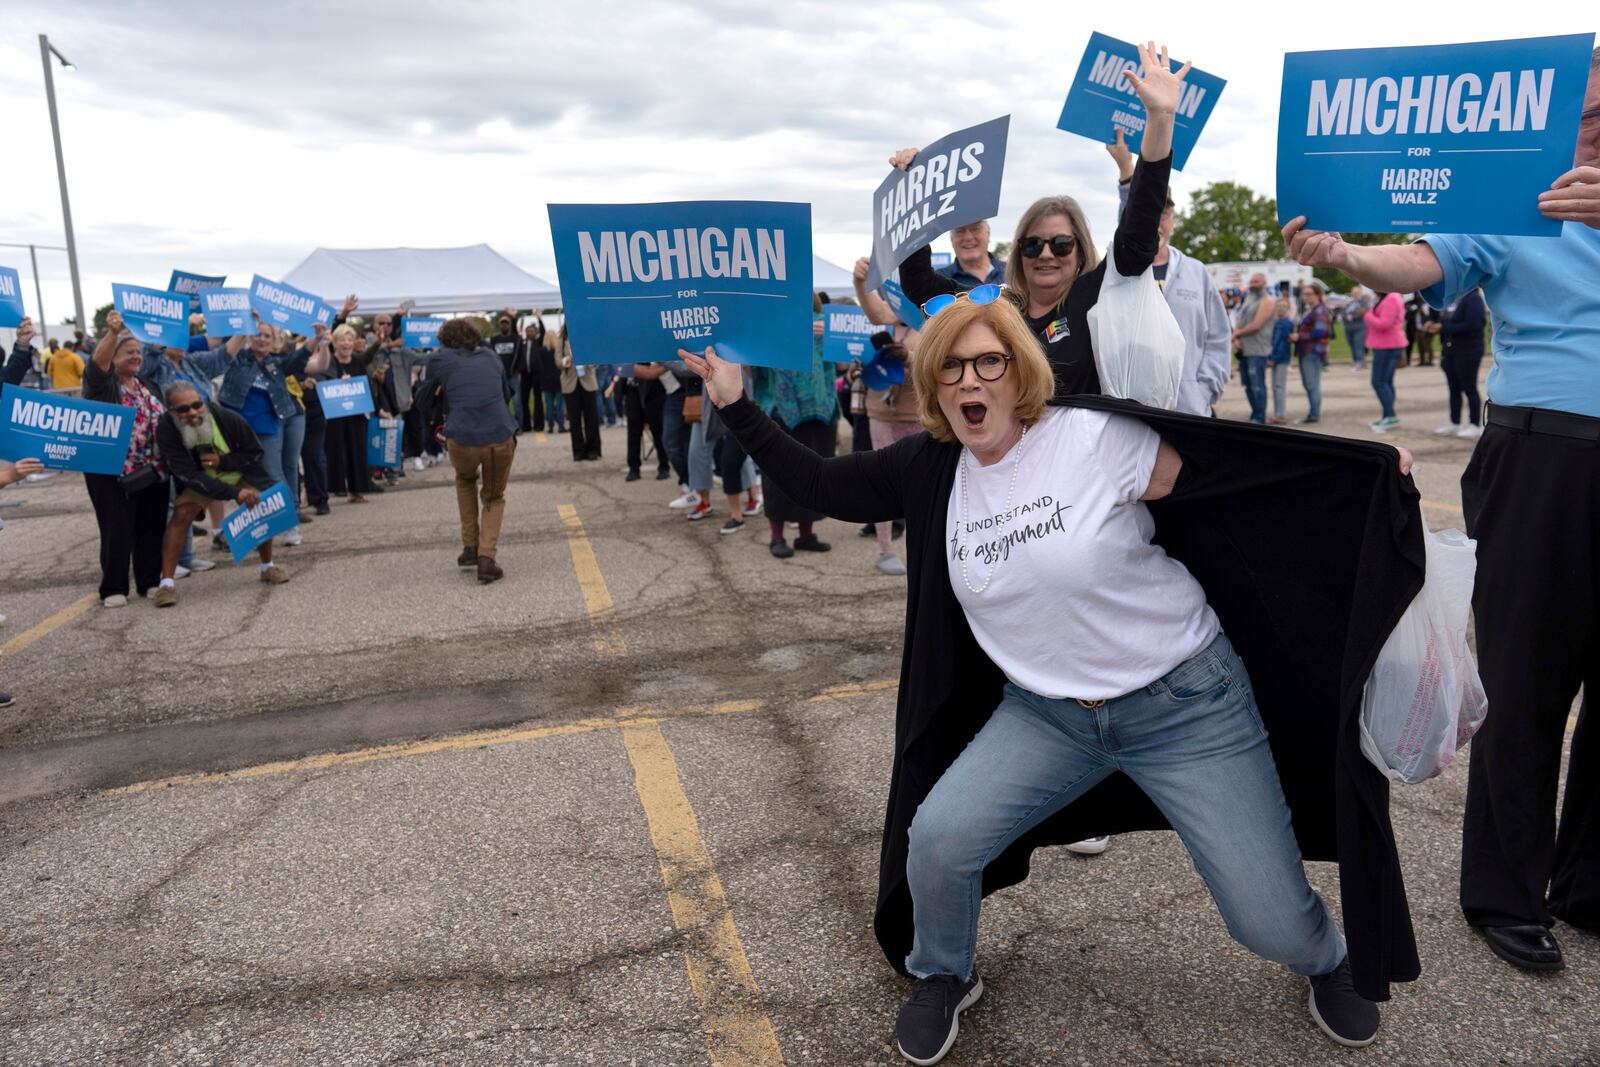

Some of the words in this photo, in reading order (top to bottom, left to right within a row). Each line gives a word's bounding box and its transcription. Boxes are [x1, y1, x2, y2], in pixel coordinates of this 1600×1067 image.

[1306, 68, 1555, 137] MICHIGAN
[1111, 109, 1146, 132] HARRIS
[1407, 147, 1431, 157] FOR
[881, 141, 985, 240] HARRIS
[1381, 168, 1452, 191] HARRIS
[1391, 192, 1438, 205] WALZ
[891, 190, 957, 252] WALZ
[577, 226, 787, 284] MICHIGAN
[122, 291, 183, 320] MICHIGAN
[256, 282, 316, 315] MICHIGAN
[677, 289, 698, 299] FOR
[660, 306, 720, 329] HARRIS
[673, 326, 713, 340] WALZ
[11, 398, 122, 438] MICHIGAN
[44, 442, 77, 456] HARRIS
[48, 453, 71, 461] WALZ
[228, 491, 285, 538] MICHIGAN
